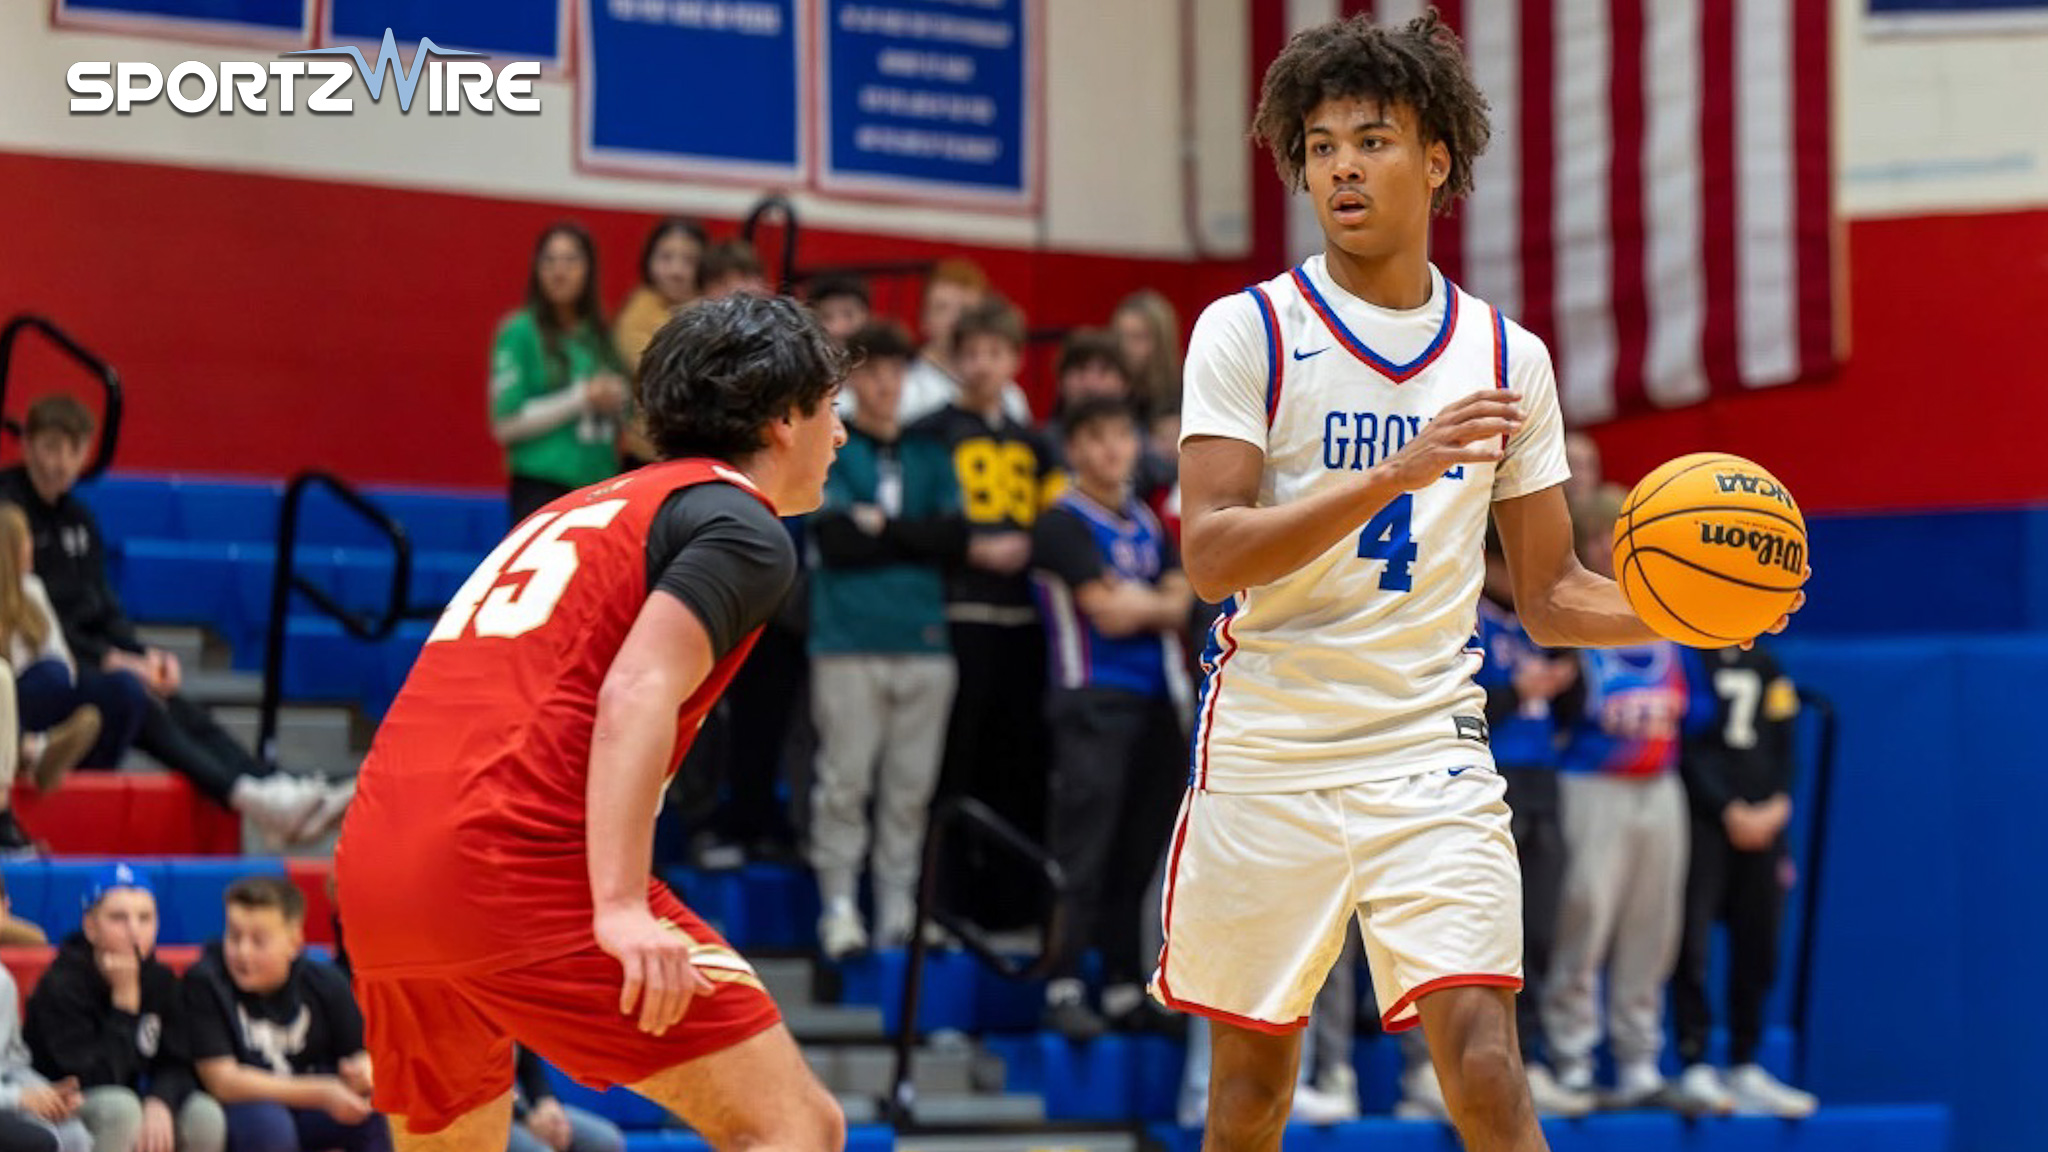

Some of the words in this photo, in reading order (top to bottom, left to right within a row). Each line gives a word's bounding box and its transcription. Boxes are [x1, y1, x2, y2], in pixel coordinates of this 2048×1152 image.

[1323, 411, 1464, 480] GRO
[425, 498, 628, 644] 45
[1357, 492, 1418, 593] 4
[1701, 522, 1803, 576] Wilson
[1714, 667, 1761, 749] 7
